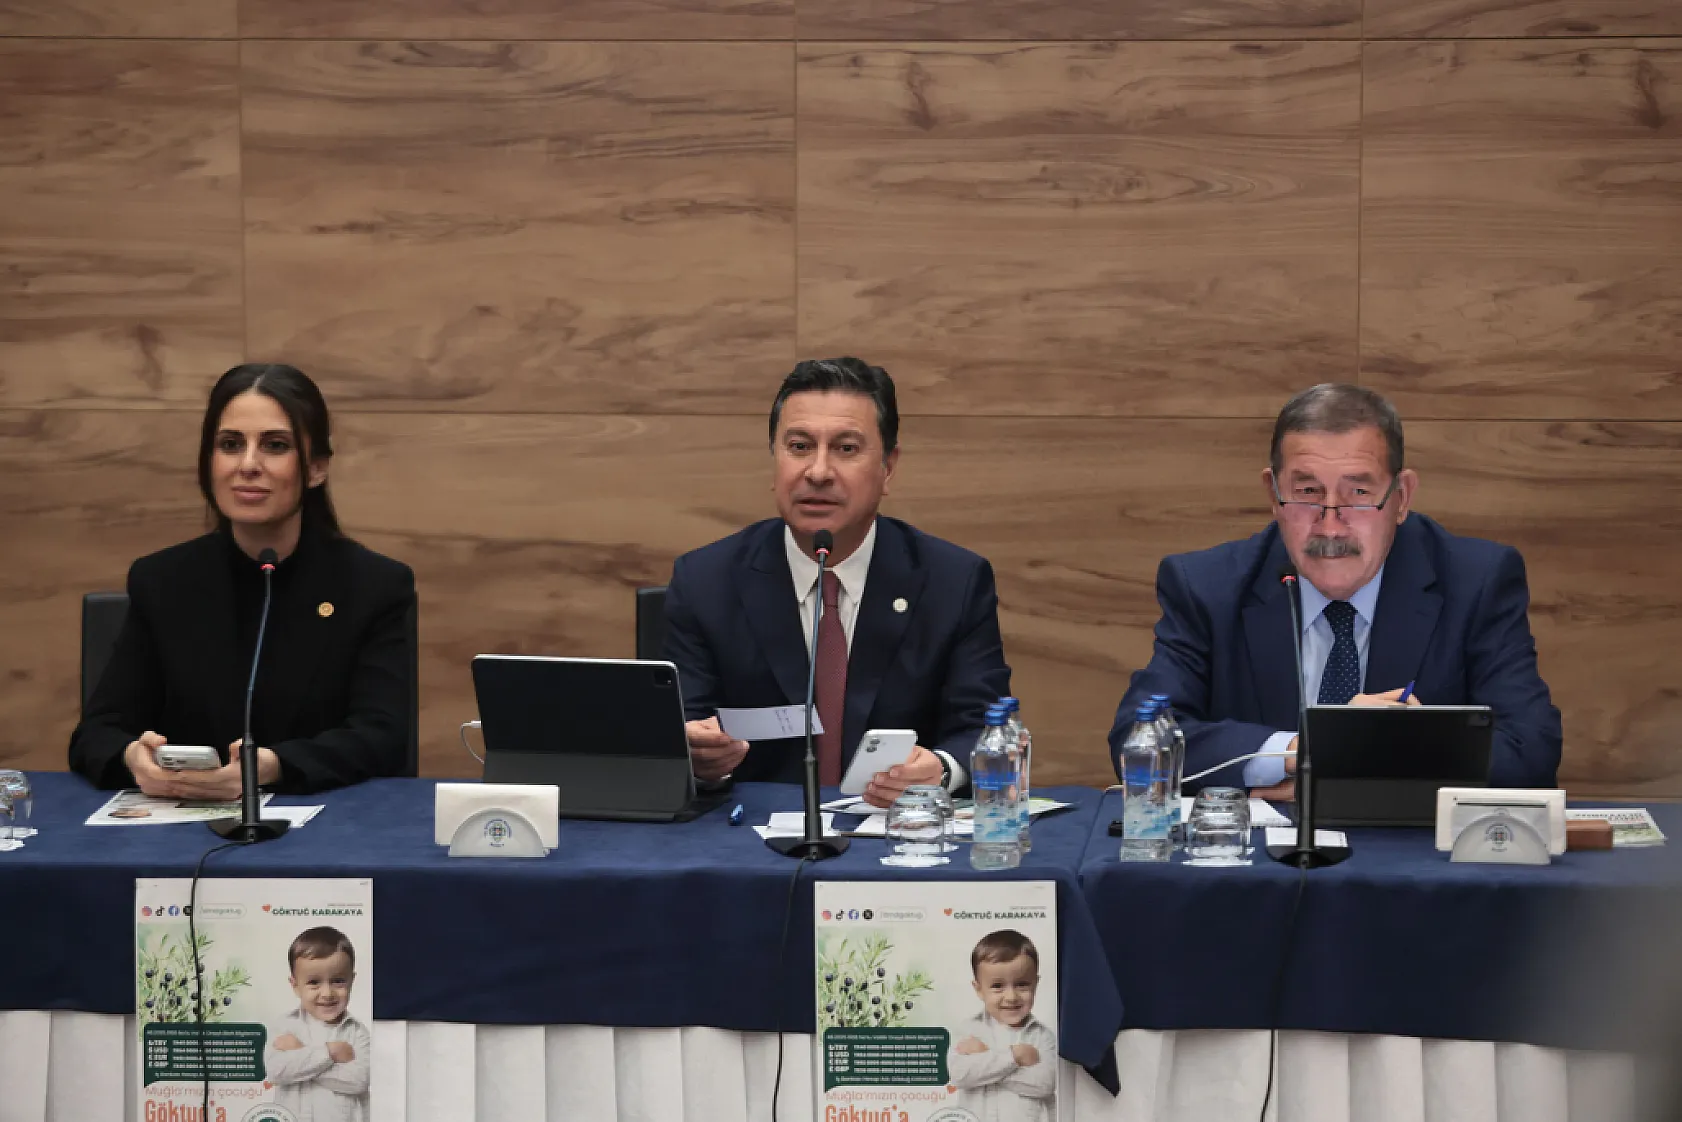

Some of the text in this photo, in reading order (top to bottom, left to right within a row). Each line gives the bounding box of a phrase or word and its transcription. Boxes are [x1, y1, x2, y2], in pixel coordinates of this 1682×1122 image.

[272, 906, 363, 916] GÖKTUĞ KARAKAYA
[953, 910, 1046, 919] GÖKTUĞ KARAKAYA
[145, 1086, 263, 1099] Muğla'mızn çocuğu
[826, 1090, 947, 1103] Muğla'mızın çocuğu
